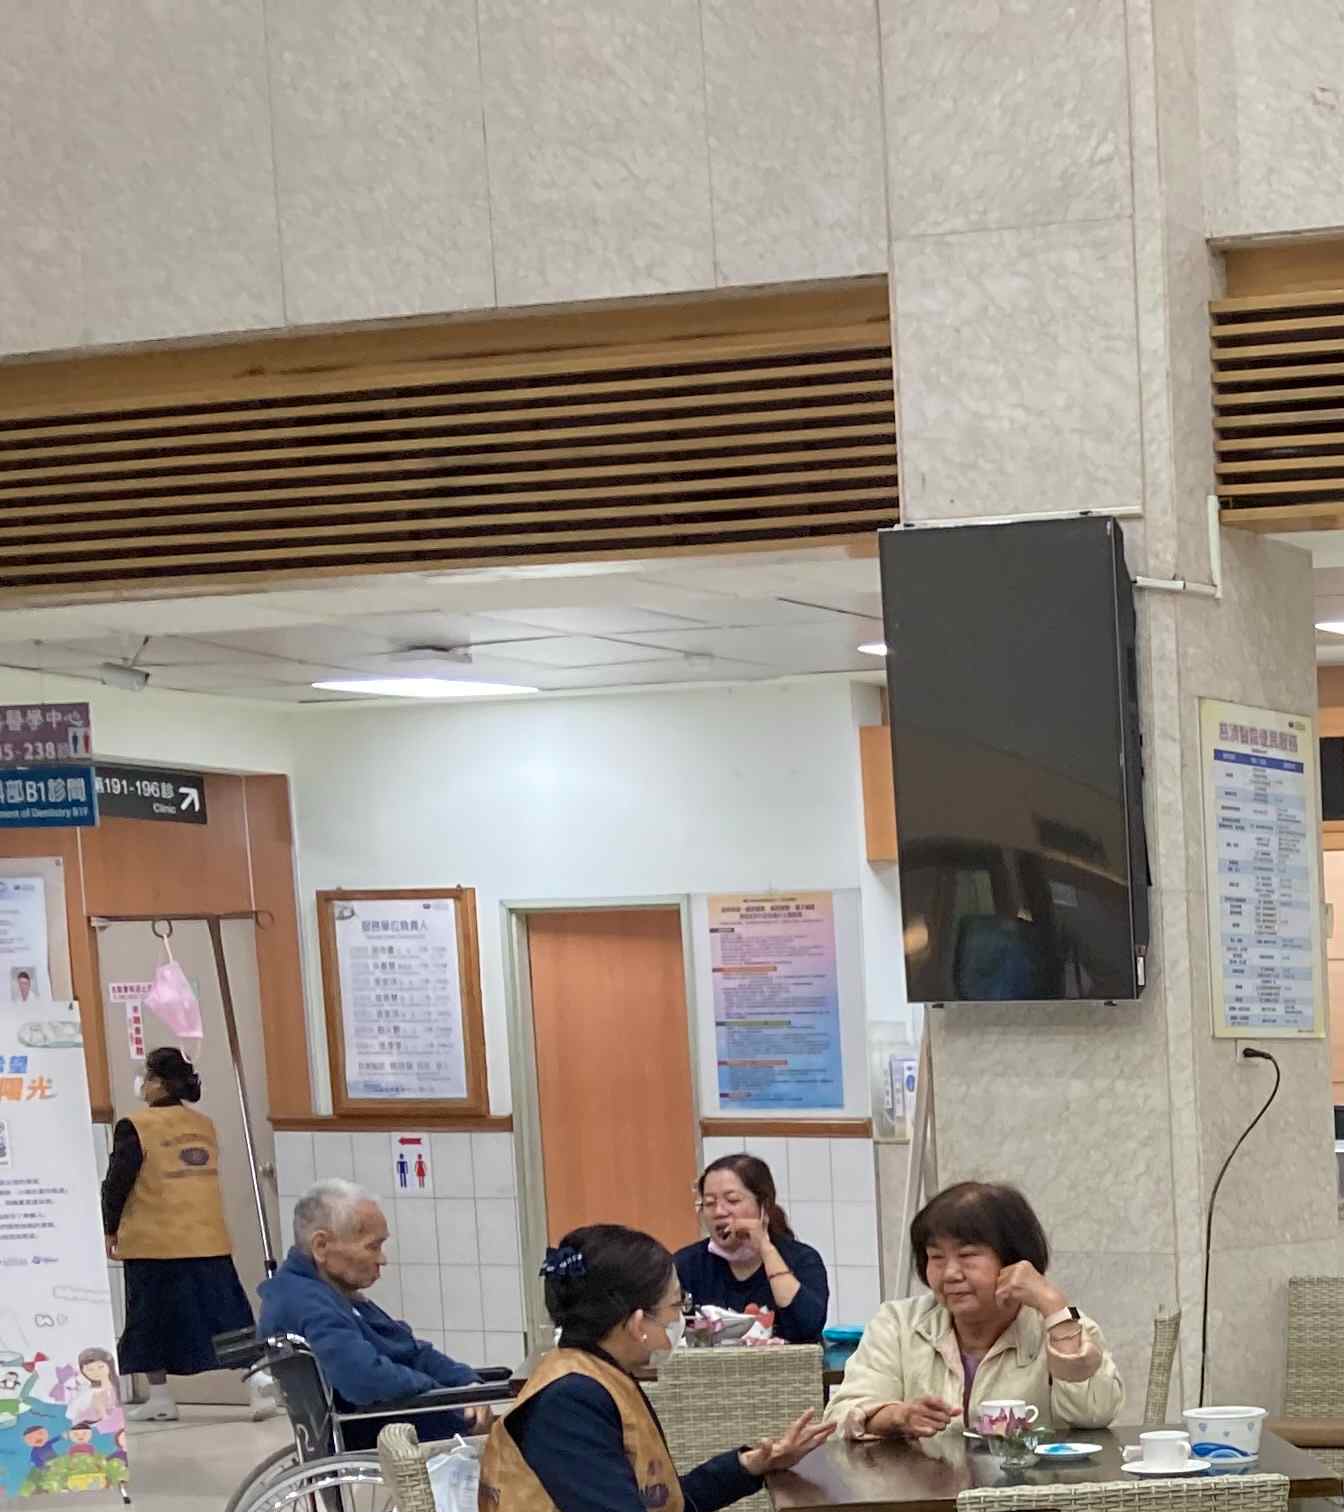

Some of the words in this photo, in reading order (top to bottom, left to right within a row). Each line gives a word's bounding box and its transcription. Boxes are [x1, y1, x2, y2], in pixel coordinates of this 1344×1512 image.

[0, 709, 83, 731] 醫學中心
[0, 778, 86, 804] 部B1診間
[153, 803, 177, 814] Clinic
